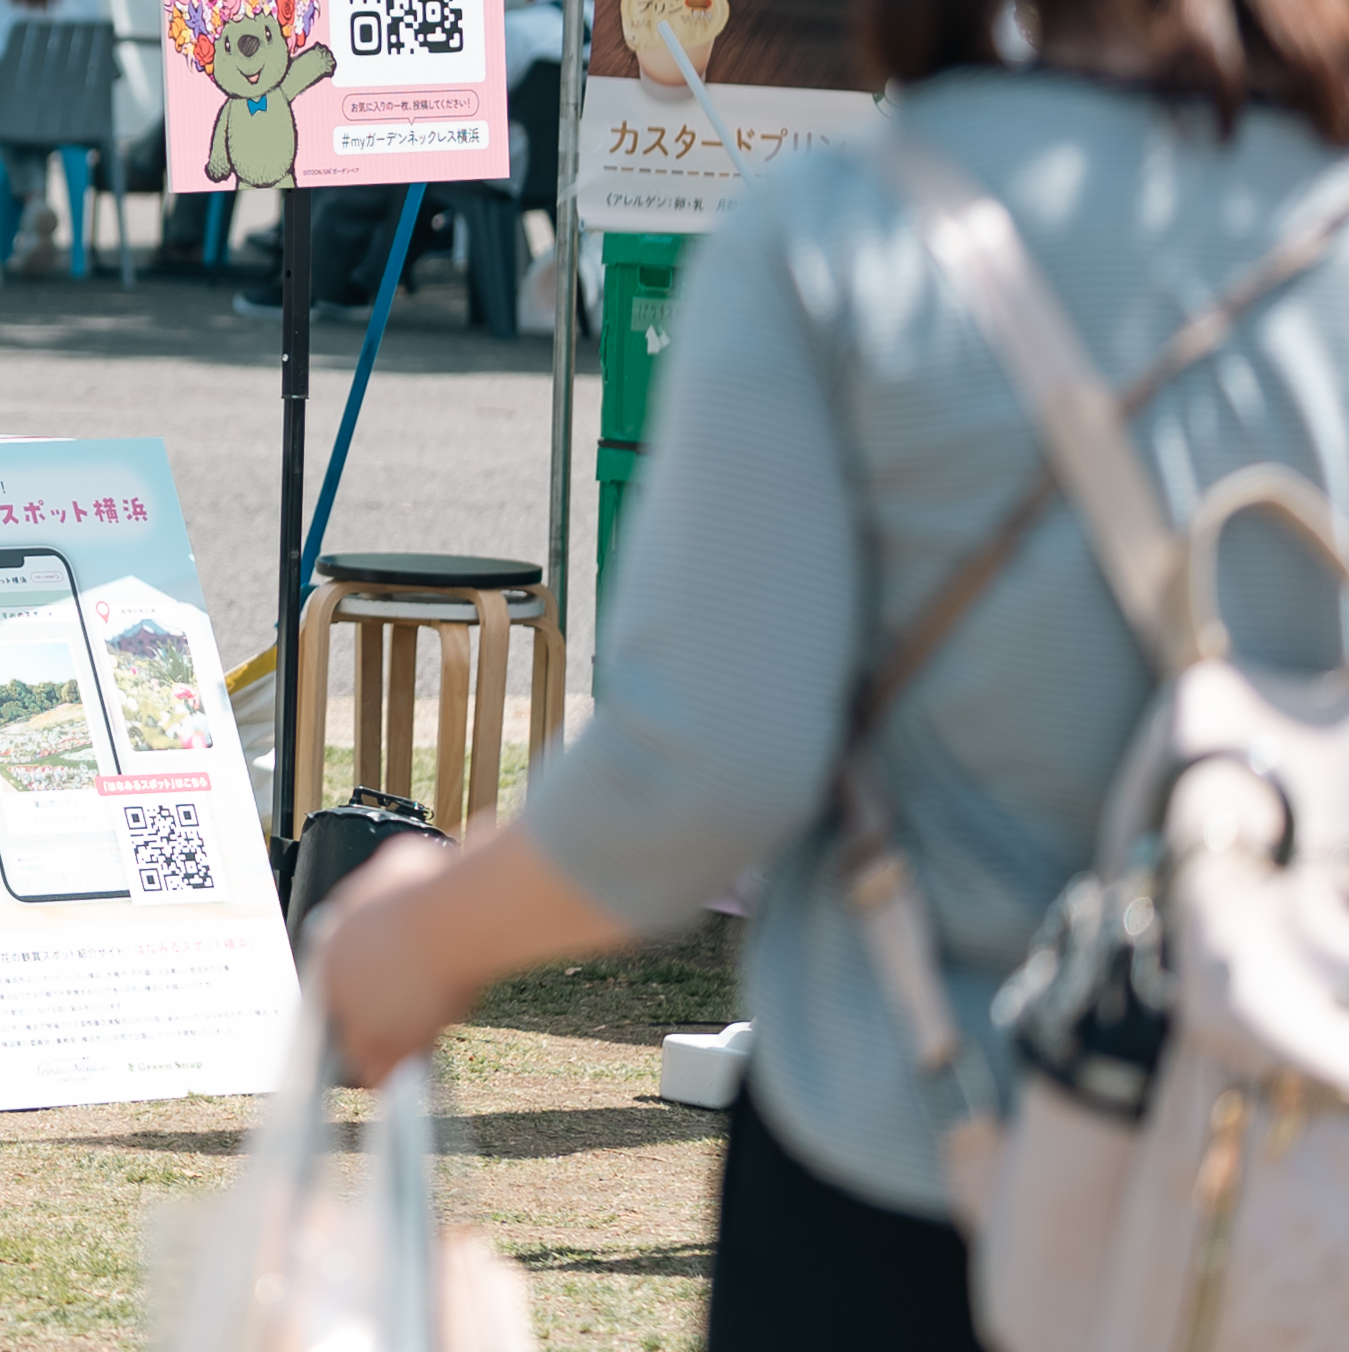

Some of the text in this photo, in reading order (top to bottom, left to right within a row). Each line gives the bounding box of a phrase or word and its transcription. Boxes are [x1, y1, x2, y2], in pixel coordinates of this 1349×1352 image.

[342, 127, 480, 150] #myガーデンネックレス横浜
